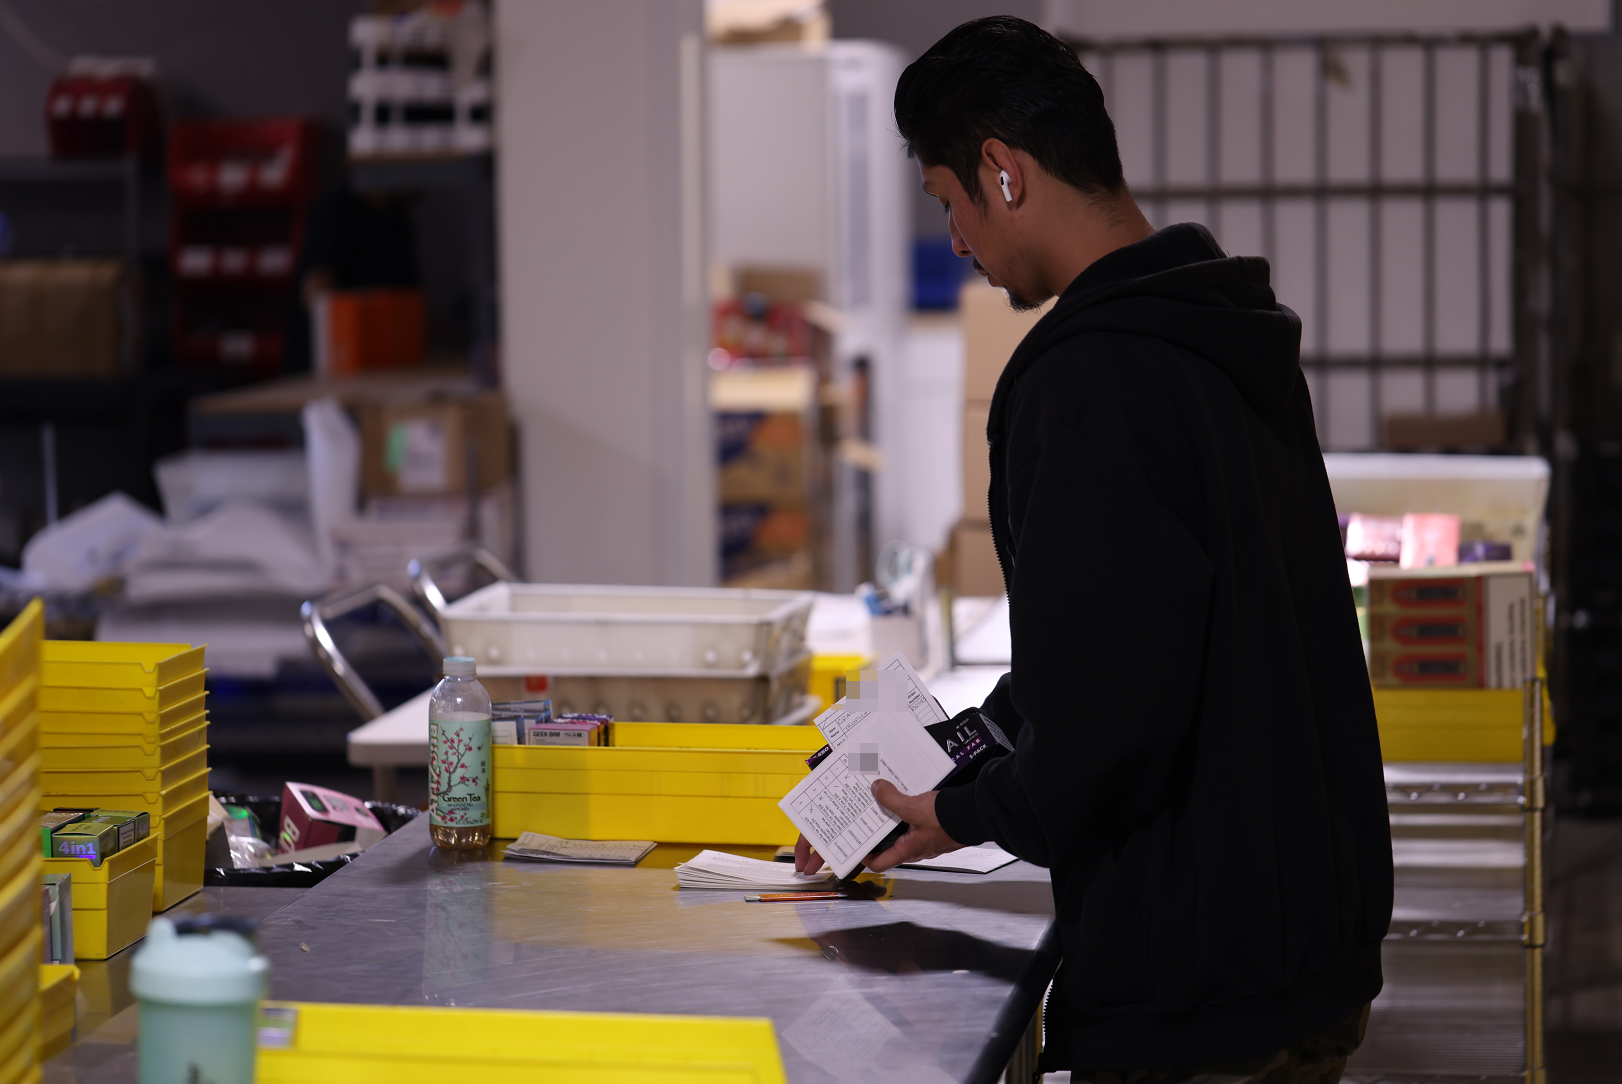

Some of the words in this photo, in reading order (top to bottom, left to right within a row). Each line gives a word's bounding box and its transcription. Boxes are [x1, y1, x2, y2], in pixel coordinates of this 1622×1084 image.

[946, 725, 977, 752] AIL
[951, 751, 965, 762] CAL
[443, 793, 467, 803] Green
[467, 793, 481, 803] Tea
[58, 841, 97, 854] 4in1
